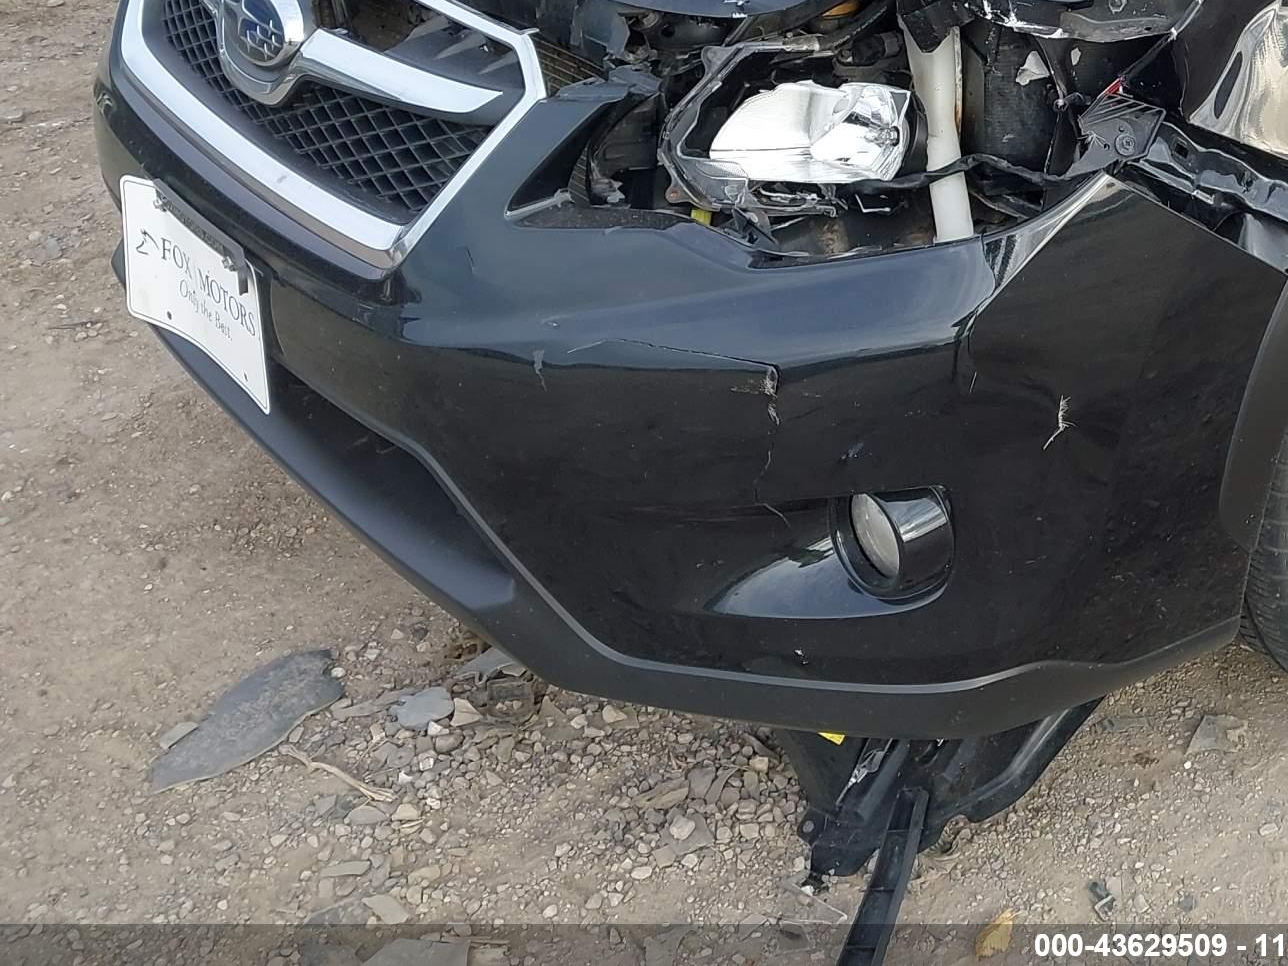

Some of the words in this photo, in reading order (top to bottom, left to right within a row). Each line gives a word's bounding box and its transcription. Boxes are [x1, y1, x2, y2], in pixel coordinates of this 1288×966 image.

[161, 237, 192, 279] FOX
[198, 268, 256, 336] MOTORS
[179, 279, 198, 313] Only
[200, 300, 213, 323] the
